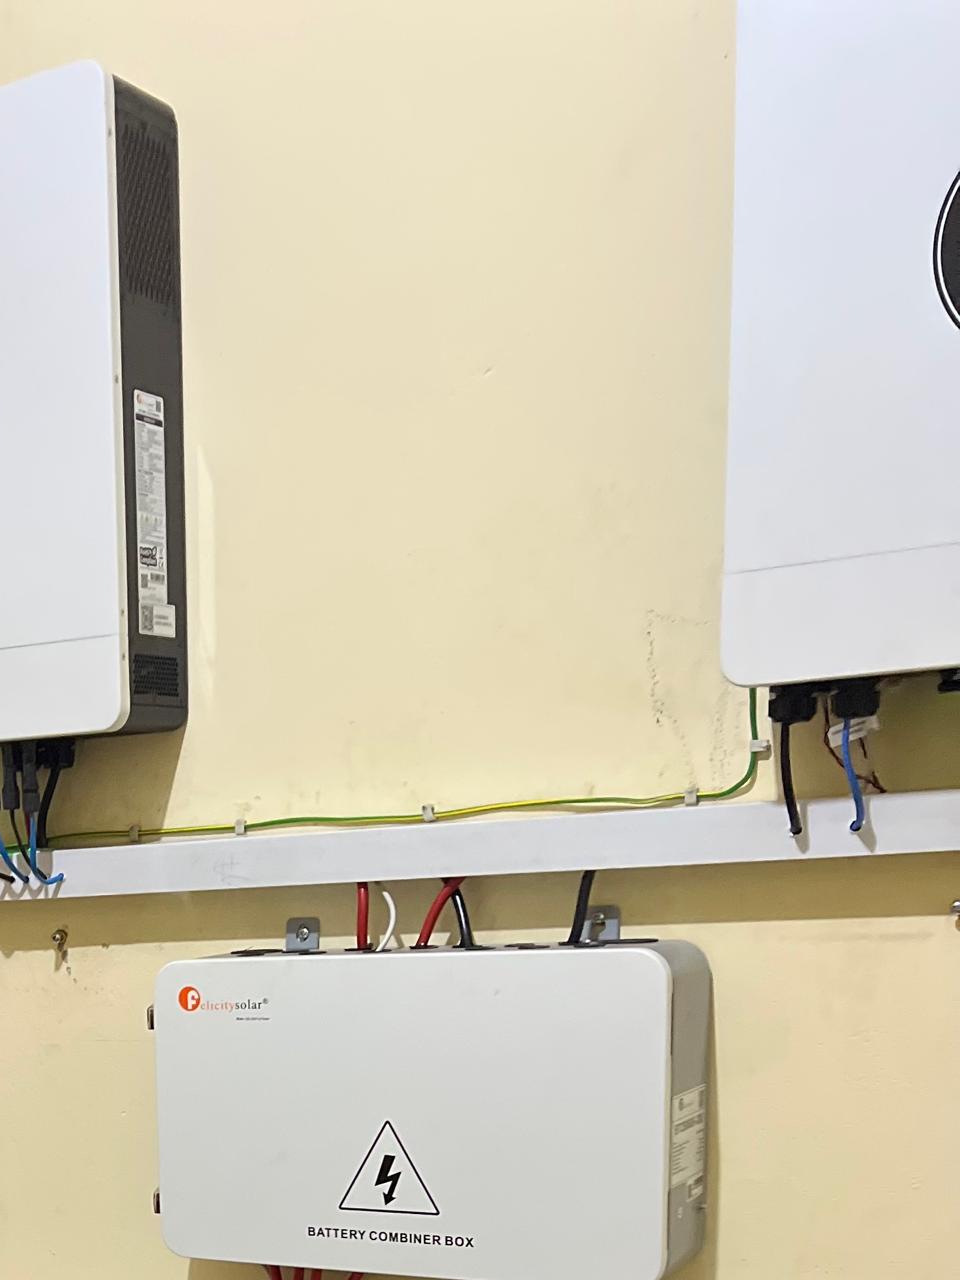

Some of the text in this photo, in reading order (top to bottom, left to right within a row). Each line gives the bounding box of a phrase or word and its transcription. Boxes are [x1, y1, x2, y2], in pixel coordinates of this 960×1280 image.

[307, 1226, 475, 1248] BATTERY COMBINER BOX
